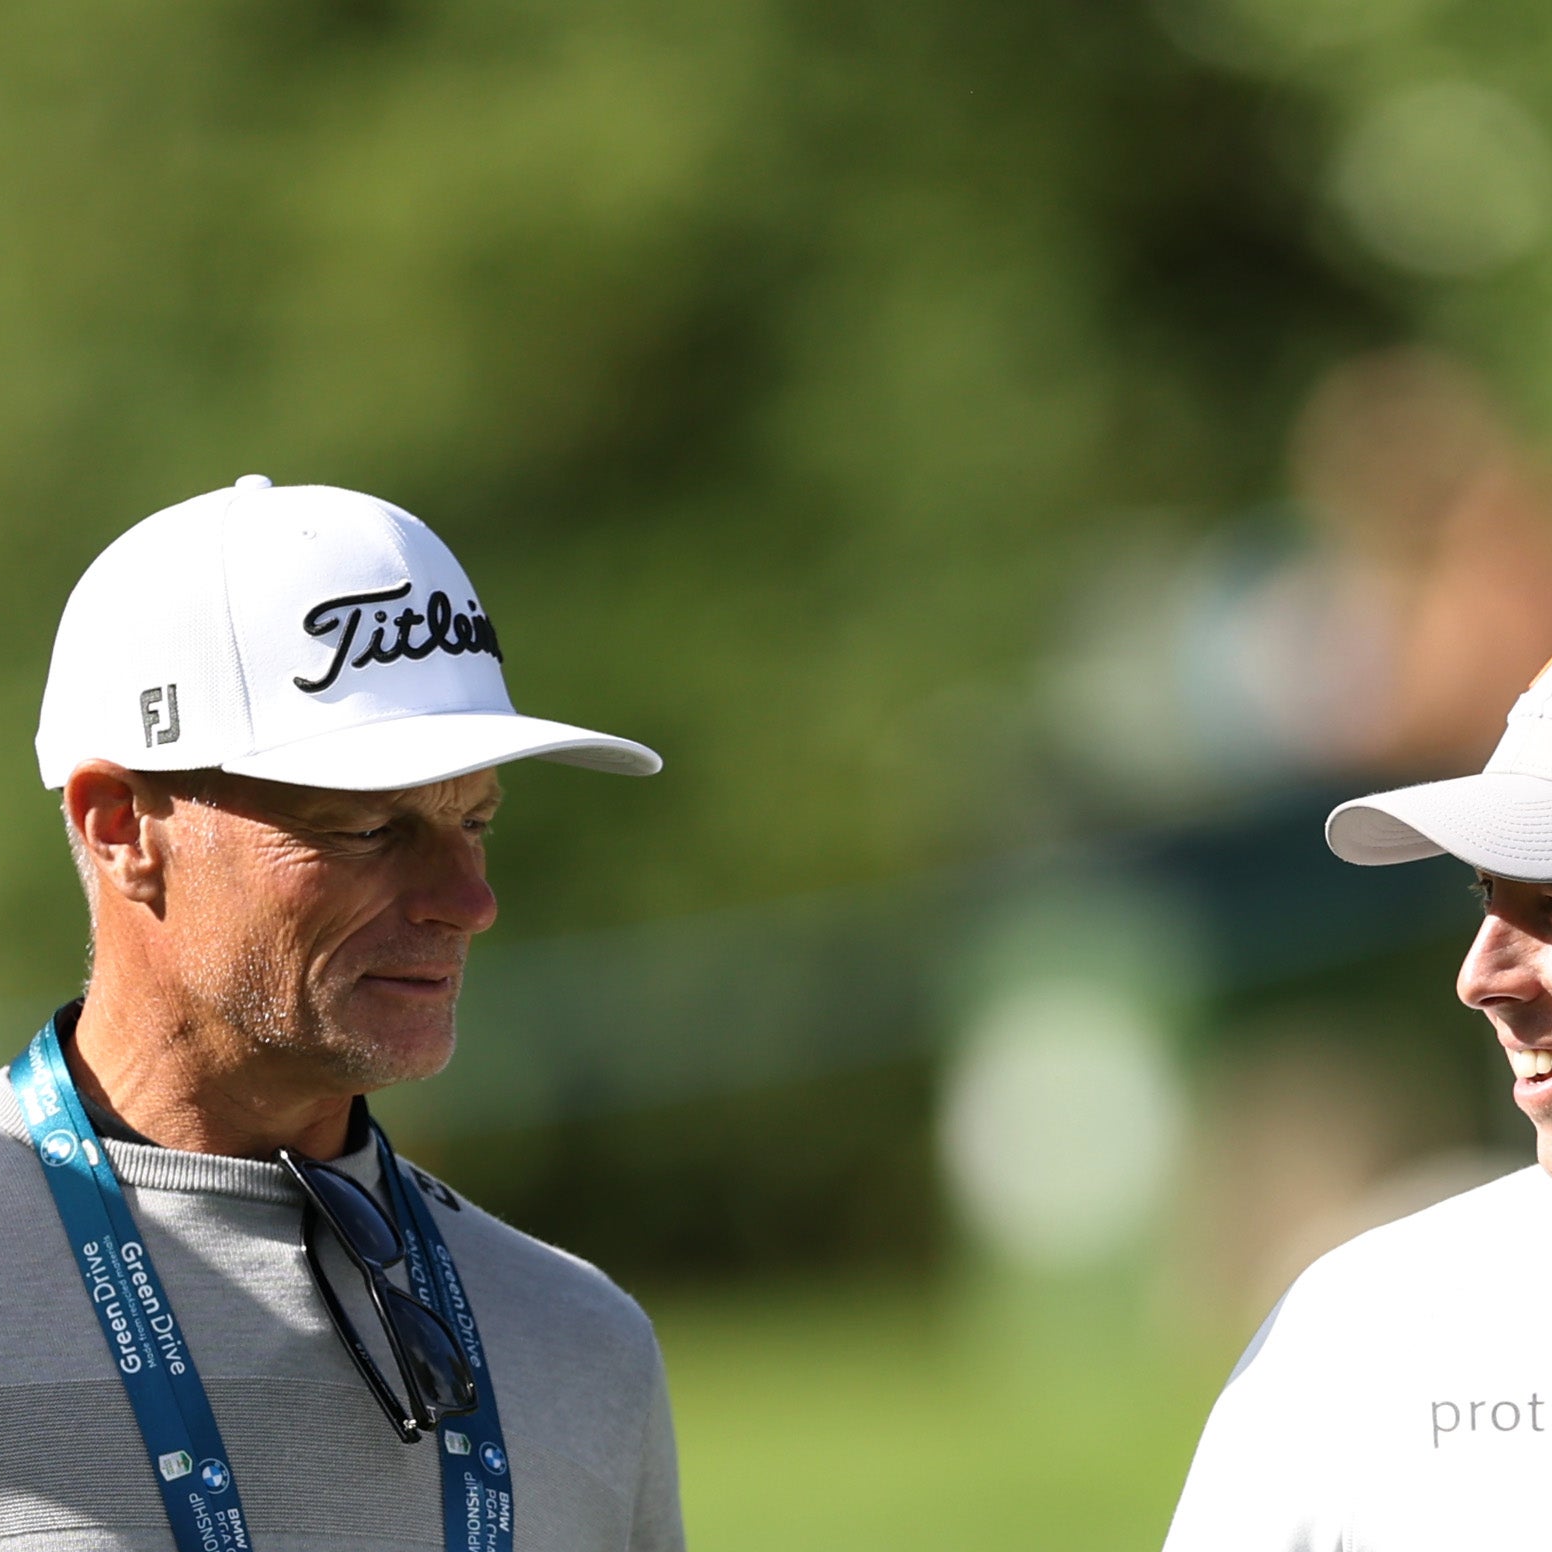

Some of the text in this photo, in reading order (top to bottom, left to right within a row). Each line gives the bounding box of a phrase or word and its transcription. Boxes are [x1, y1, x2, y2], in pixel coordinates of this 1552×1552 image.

[293, 582, 504, 693] Titlei
[139, 684, 181, 748] FJ
[83, 1241, 142, 1374] Green Drive
[121, 1241, 186, 1376] Green Drive
[134, 1317, 147, 1341] from
[436, 1244, 465, 1309] Green
[457, 1312, 481, 1369] Drive
[227, 1508, 248, 1549] BMW
[485, 1488, 497, 1520] PGA
[499, 1491, 510, 1533] BMW
